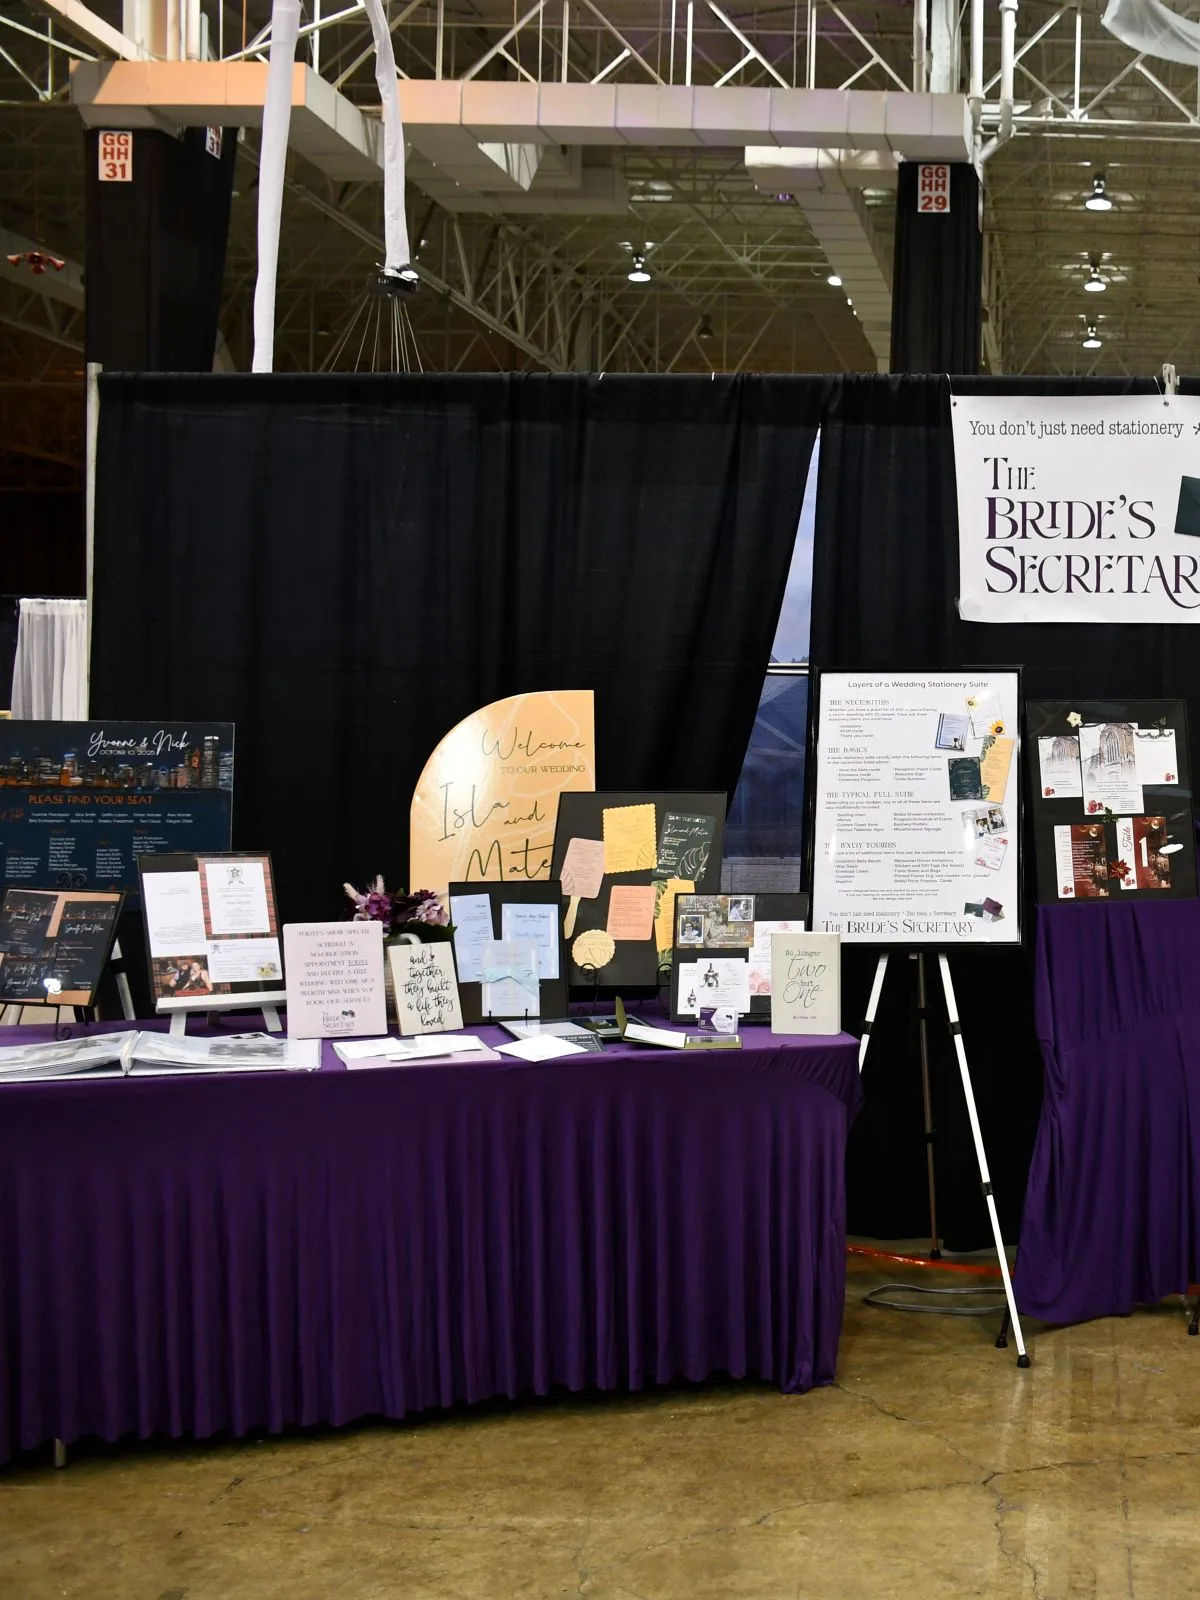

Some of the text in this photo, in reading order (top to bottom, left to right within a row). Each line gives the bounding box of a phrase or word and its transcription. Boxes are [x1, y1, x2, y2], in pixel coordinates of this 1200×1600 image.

[102, 132, 129, 146] GG
[102, 147, 128, 160] HH
[105, 162, 127, 179] 31
[921, 166, 947, 179] GG
[921, 179, 946, 192] HH
[921, 195, 947, 211] 29
[969, 420, 995, 436] You
[999, 420, 1036, 436] don't
[1038, 421, 1067, 439] just
[1070, 420, 1105, 436] need
[1108, 421, 1184, 439] stationery
[847, 681, 873, 689] Layers
[891, 681, 926, 689] Wedding
[928, 680, 967, 689] Stationery
[969, 680, 989, 688] Suite
[87, 731, 136, 757] Yvonne
[152, 730, 192, 756] Nick
[480, 726, 586, 760] Welcome
[516, 765, 538, 774] OUR
[540, 764, 586, 773] WEDDING
[28, 795, 153, 805] PLEASE FIND YOUR SEAT
[438, 781, 510, 842] Isla
[503, 800, 546, 826] and
[1121, 826, 1133, 852] Table
[464, 838, 554, 881] Mate
[1138, 836, 1149, 868] 1
[409, 951, 428, 964] and
[797, 949, 822, 958] longer
[408, 964, 445, 983] together
[787, 954, 827, 980] two
[402, 979, 453, 998] they built
[783, 981, 823, 1009] One
[416, 998, 433, 1014] life
[432, 995, 454, 1011] they
[419, 1013, 446, 1027] loved
